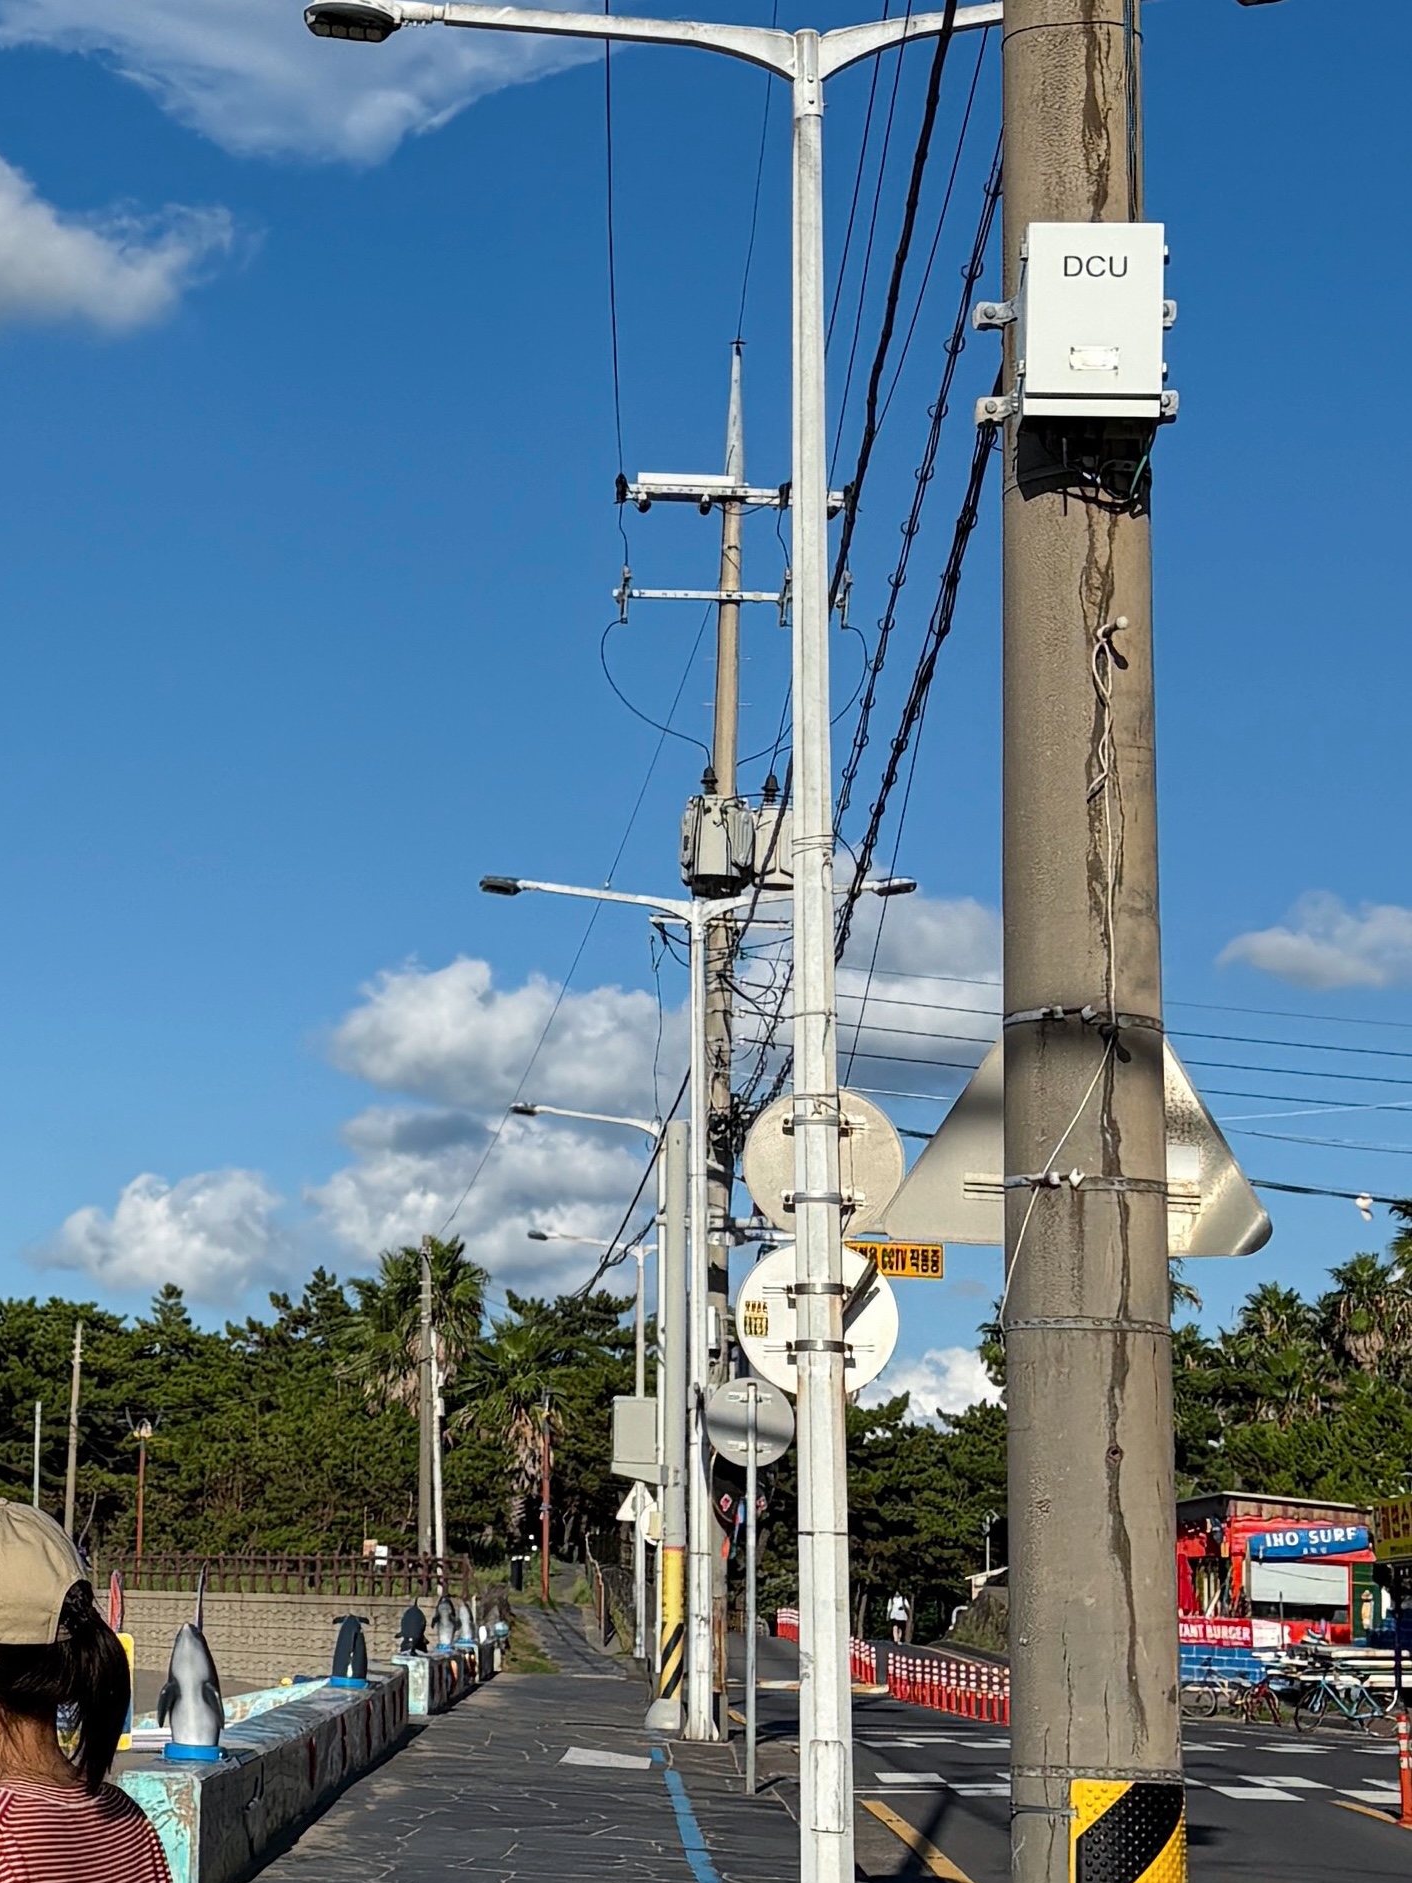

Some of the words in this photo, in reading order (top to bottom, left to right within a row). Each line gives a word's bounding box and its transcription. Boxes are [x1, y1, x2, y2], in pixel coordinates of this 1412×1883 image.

[1063, 255, 1128, 277] DCU
[881, 1247, 907, 1271] CCTV
[1308, 1526, 1357, 1545] SURF
[1205, 1624, 1251, 1641] BURGER
